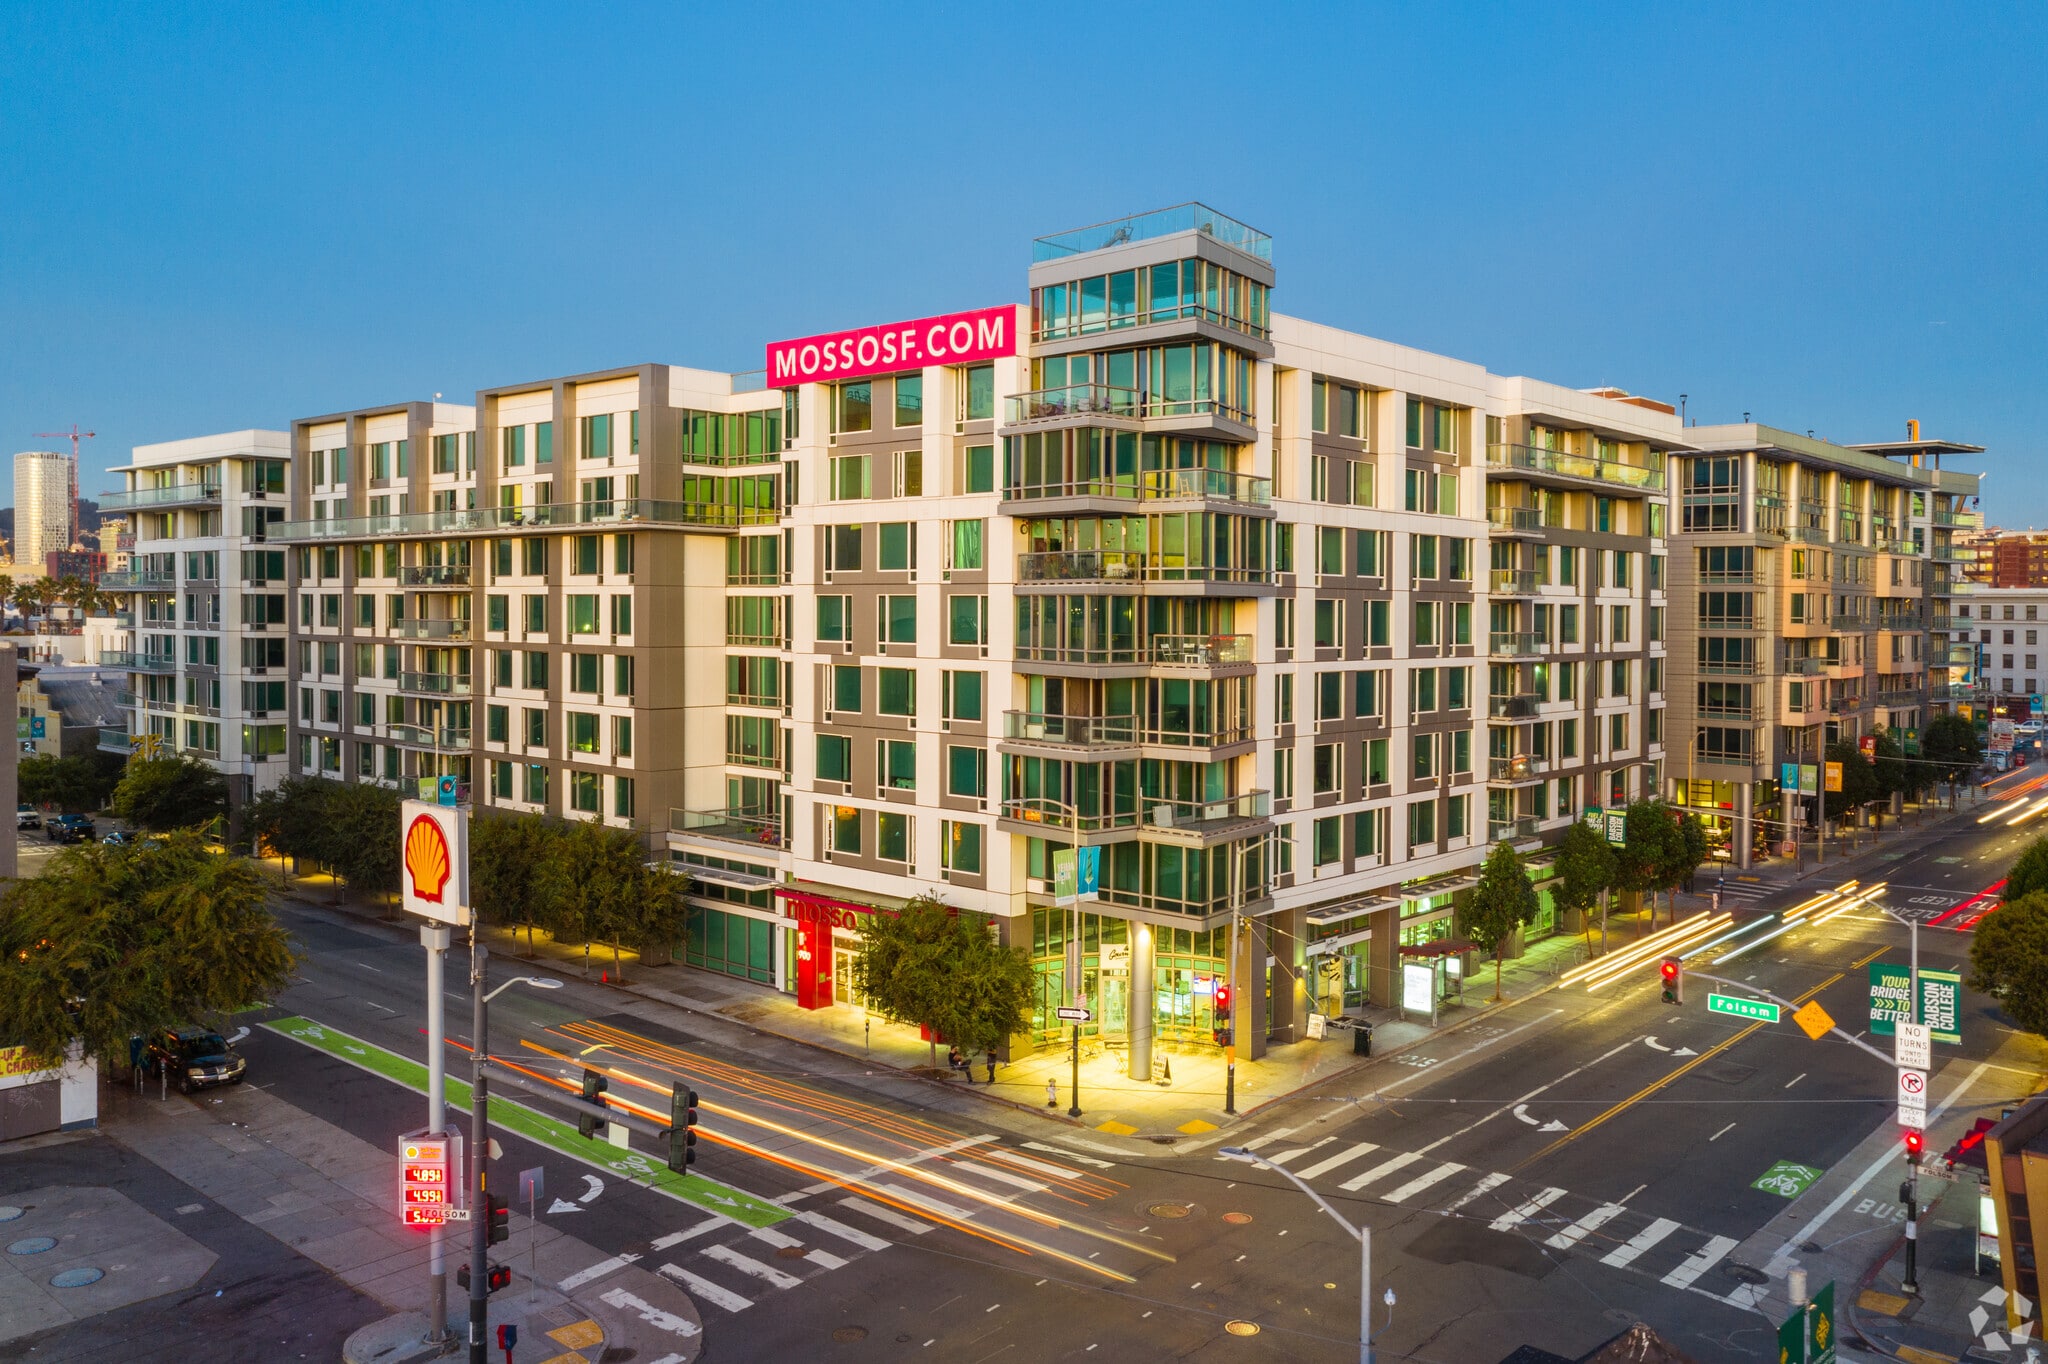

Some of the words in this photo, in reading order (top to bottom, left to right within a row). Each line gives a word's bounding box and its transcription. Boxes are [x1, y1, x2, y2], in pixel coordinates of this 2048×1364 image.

[776, 316, 1004, 379] MOSSOSF.COM
[1881, 975, 1910, 989] YOUR
[1870, 985, 1911, 1001] BRIDGE
[1717, 999, 1770, 1017] Folsom
[1896, 1000, 1911, 1012] TO
[1924, 981, 1940, 1029] BABSON
[1939, 983, 1955, 1031] COLLEGE
[1870, 1007, 1911, 1023] BETTER
[1905, 1027, 1921, 1037] NO
[1899, 1037, 1928, 1050] TURNS
[1900, 1056, 1926, 1066] MARKET
[1904, 1050, 1921, 1058] ONTO
[1923, 1168, 1953, 1179] FOLSOM
[425, 1210, 467, 1219] FOLSOM
[1853, 1198, 1909, 1221] BUS
